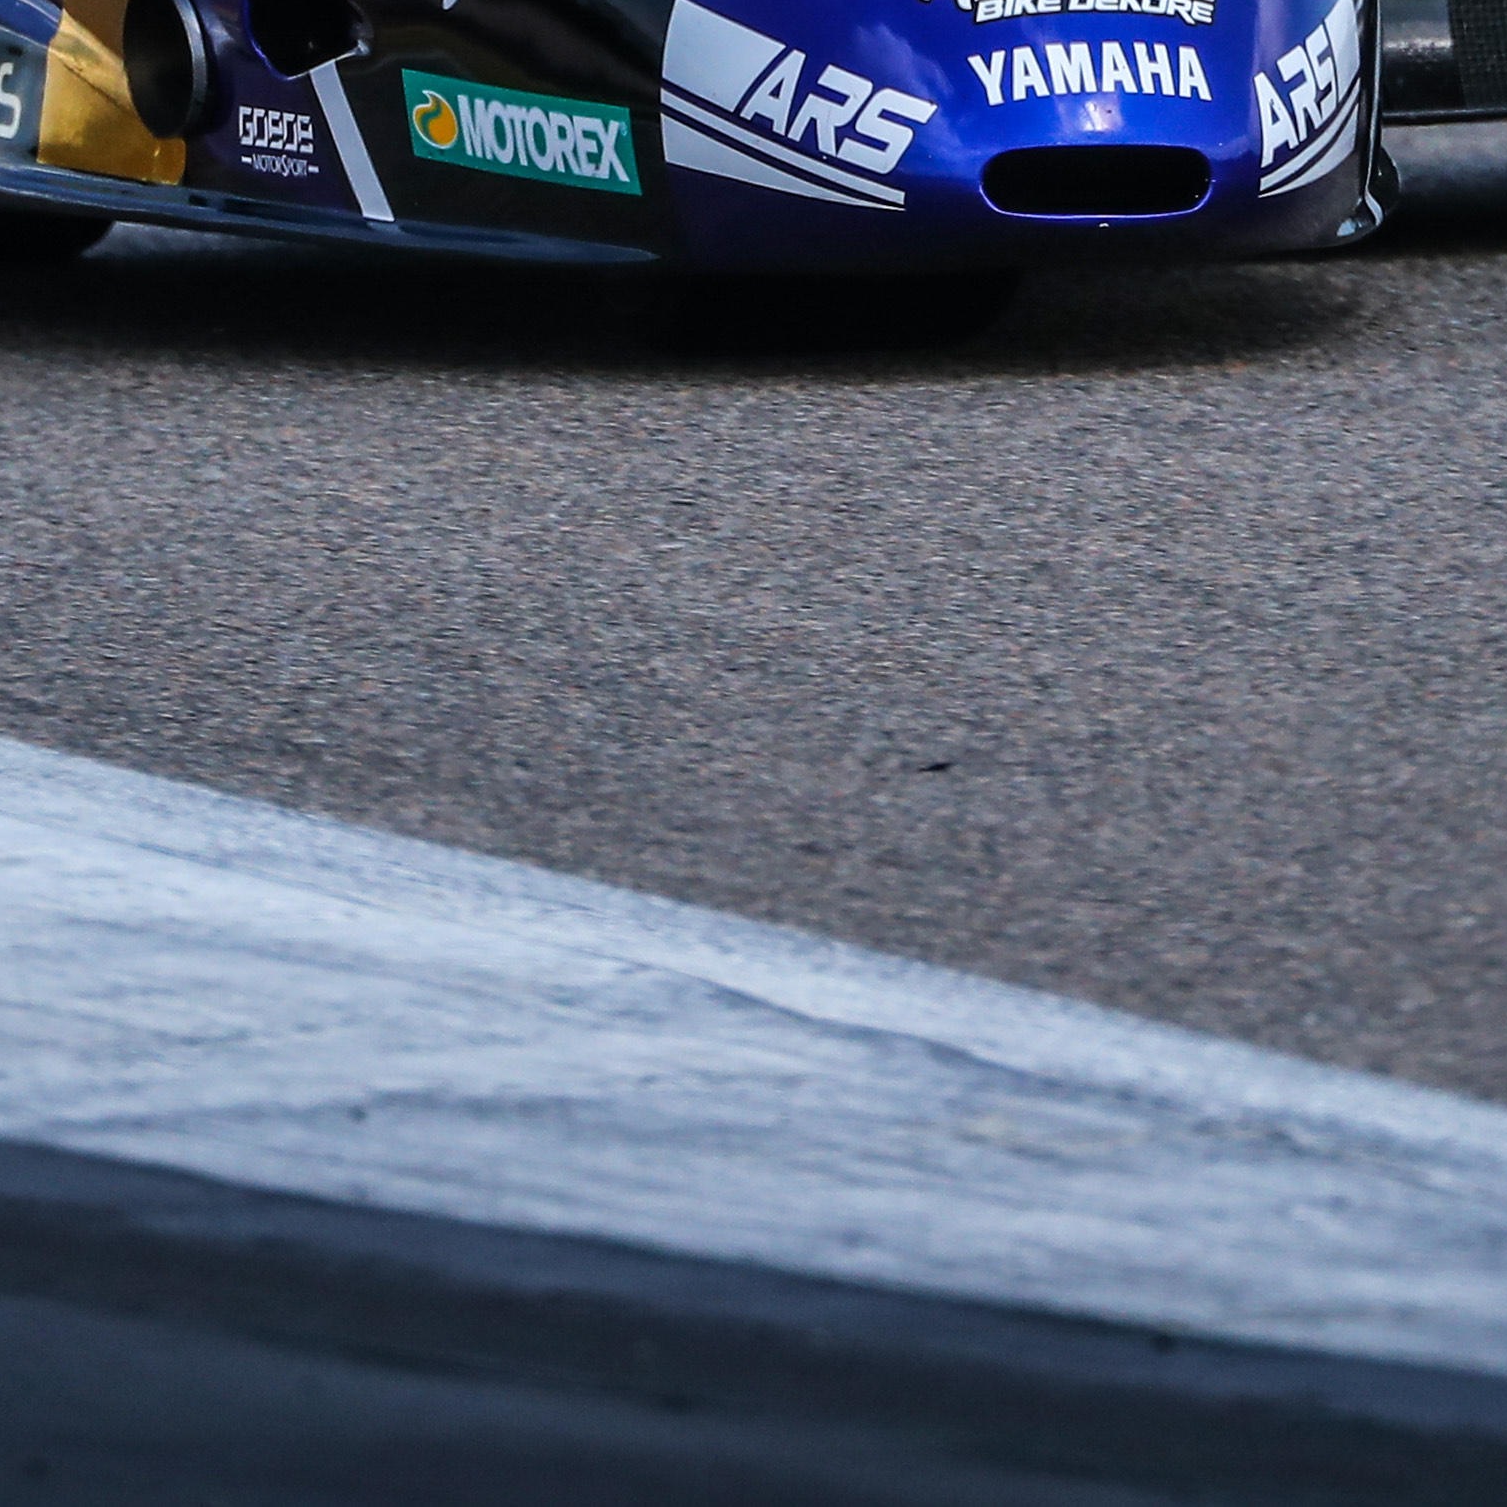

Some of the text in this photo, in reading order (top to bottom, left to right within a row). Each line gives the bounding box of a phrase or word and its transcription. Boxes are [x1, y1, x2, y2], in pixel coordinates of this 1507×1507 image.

[740, 50, 939, 175] ARS
[967, 41, 1213, 106] YAMAHA
[1253, 23, 1339, 169] ARS
[456, 94, 630, 182] MOTOREX
